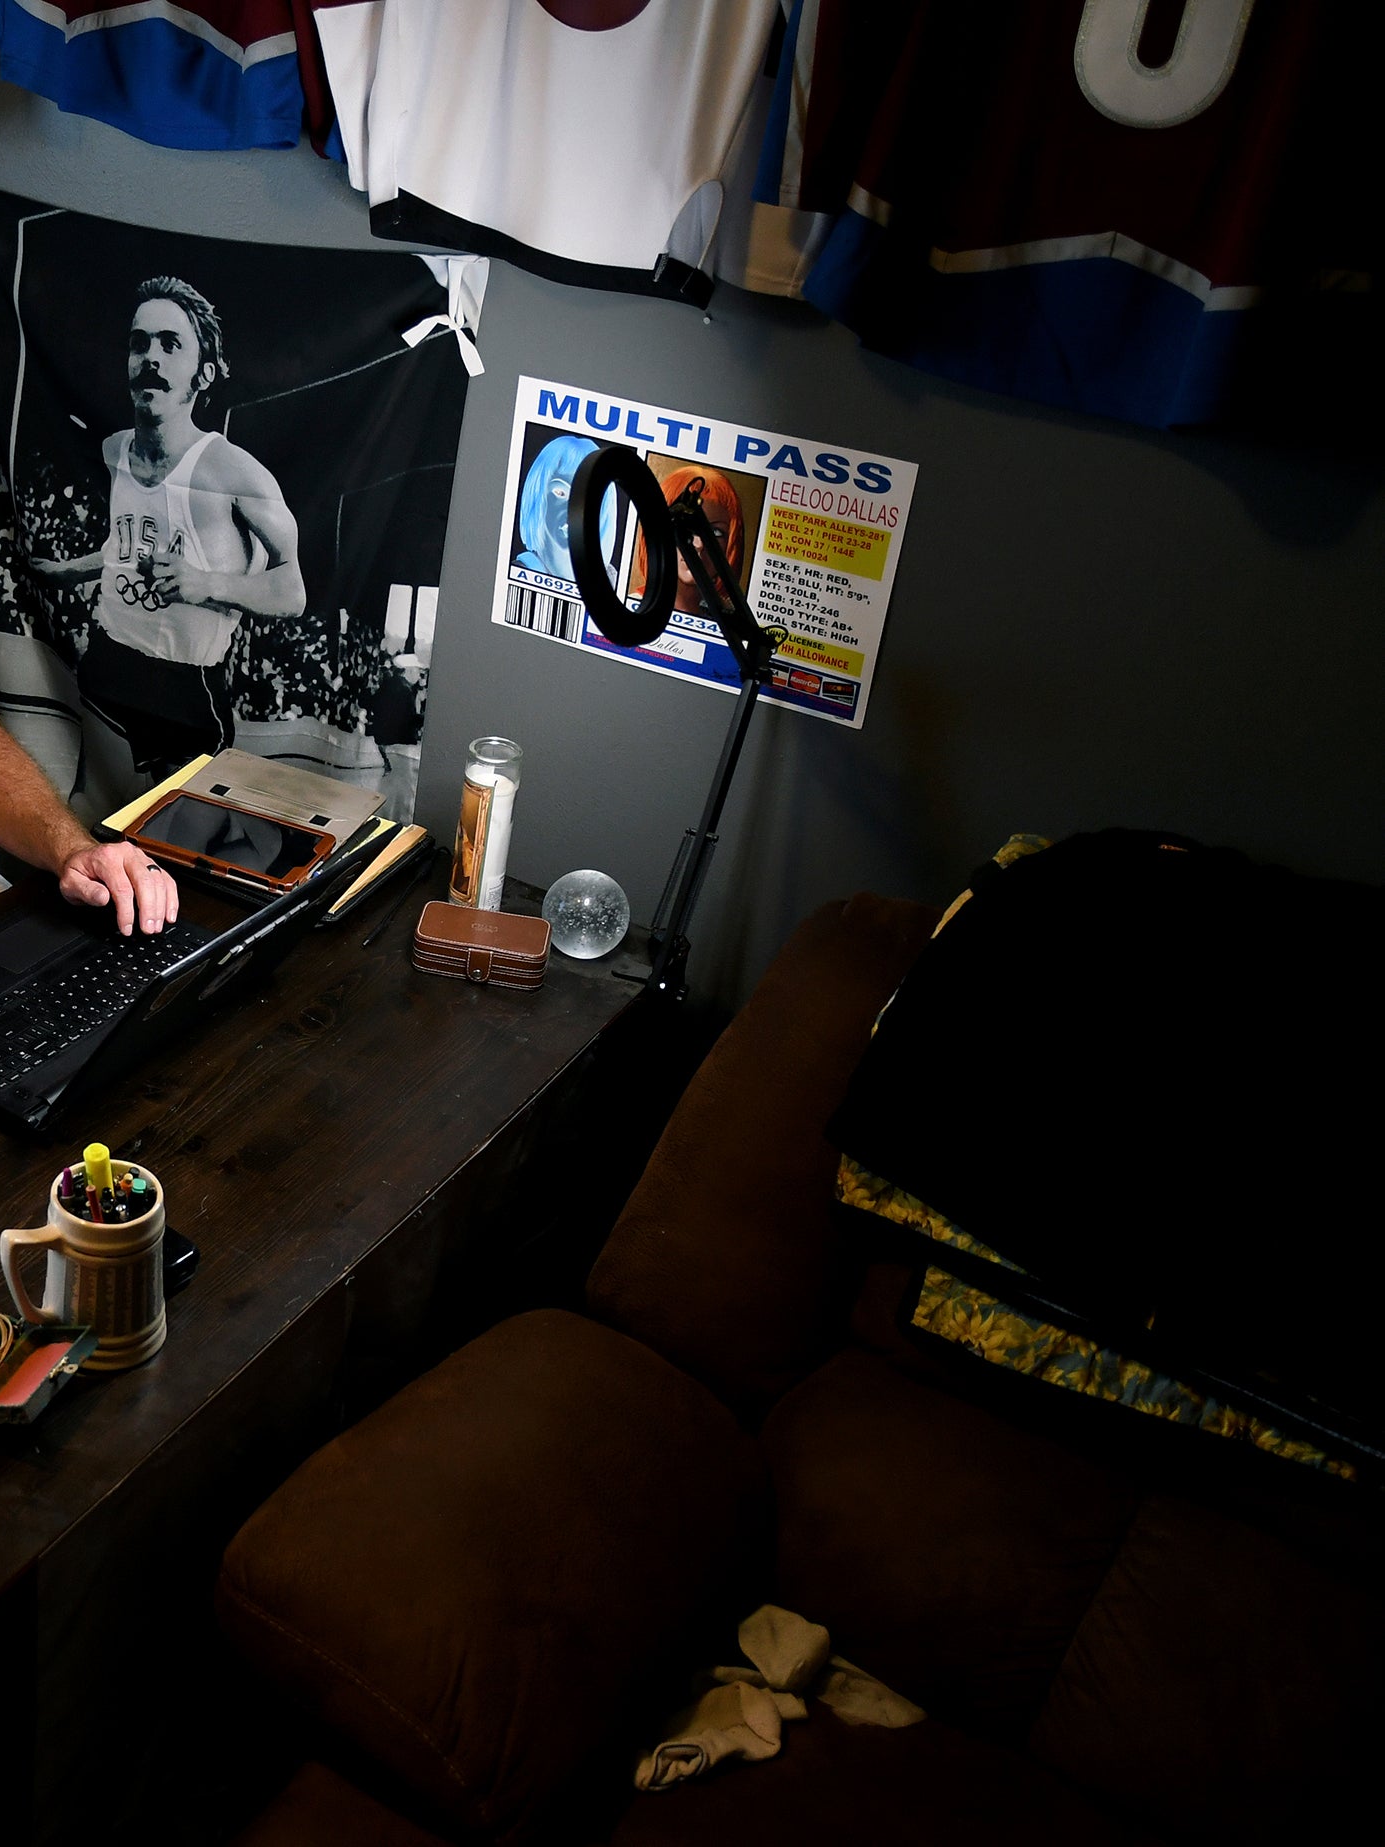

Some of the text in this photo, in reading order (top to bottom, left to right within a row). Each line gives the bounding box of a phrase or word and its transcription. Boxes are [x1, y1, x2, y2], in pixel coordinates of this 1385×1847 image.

[537, 389, 892, 494] MULTI PASS
[770, 479, 899, 528] LEELOO DALLAS
[116, 513, 185, 564] USA
[771, 520, 800, 533] LEVEL
[804, 528, 814, 536] 21
[822, 532, 844, 544] PIER
[846, 537, 872, 550] 23-28
[773, 508, 885, 542] WEST PARK ALLEYS-281
[768, 541, 828, 562] NY, NY 10024
[770, 530, 783, 540] HA
[791, 536, 811, 546] CON
[814, 541, 825, 549] 37
[833, 546, 855, 558] 144E
[517, 571, 580, 595] A 0692
[763, 569, 795, 584] EYES:
[798, 578, 822, 592] BLU,
[825, 585, 844, 597] HT:
[765, 558, 852, 589] SEX: F, HR: RED,
[759, 590, 840, 618] DOB: 12-17-246
[761, 580, 820, 603] WT: 120LB,
[672, 613, 720, 634] 0234
[756, 611, 859, 645] VIRAL STATE: HIGH
[757, 601, 854, 632] BLOOD TYPE: AB+
[789, 635, 825, 651] LICENSE:
[796, 647, 849, 670] ALLOWANCE
